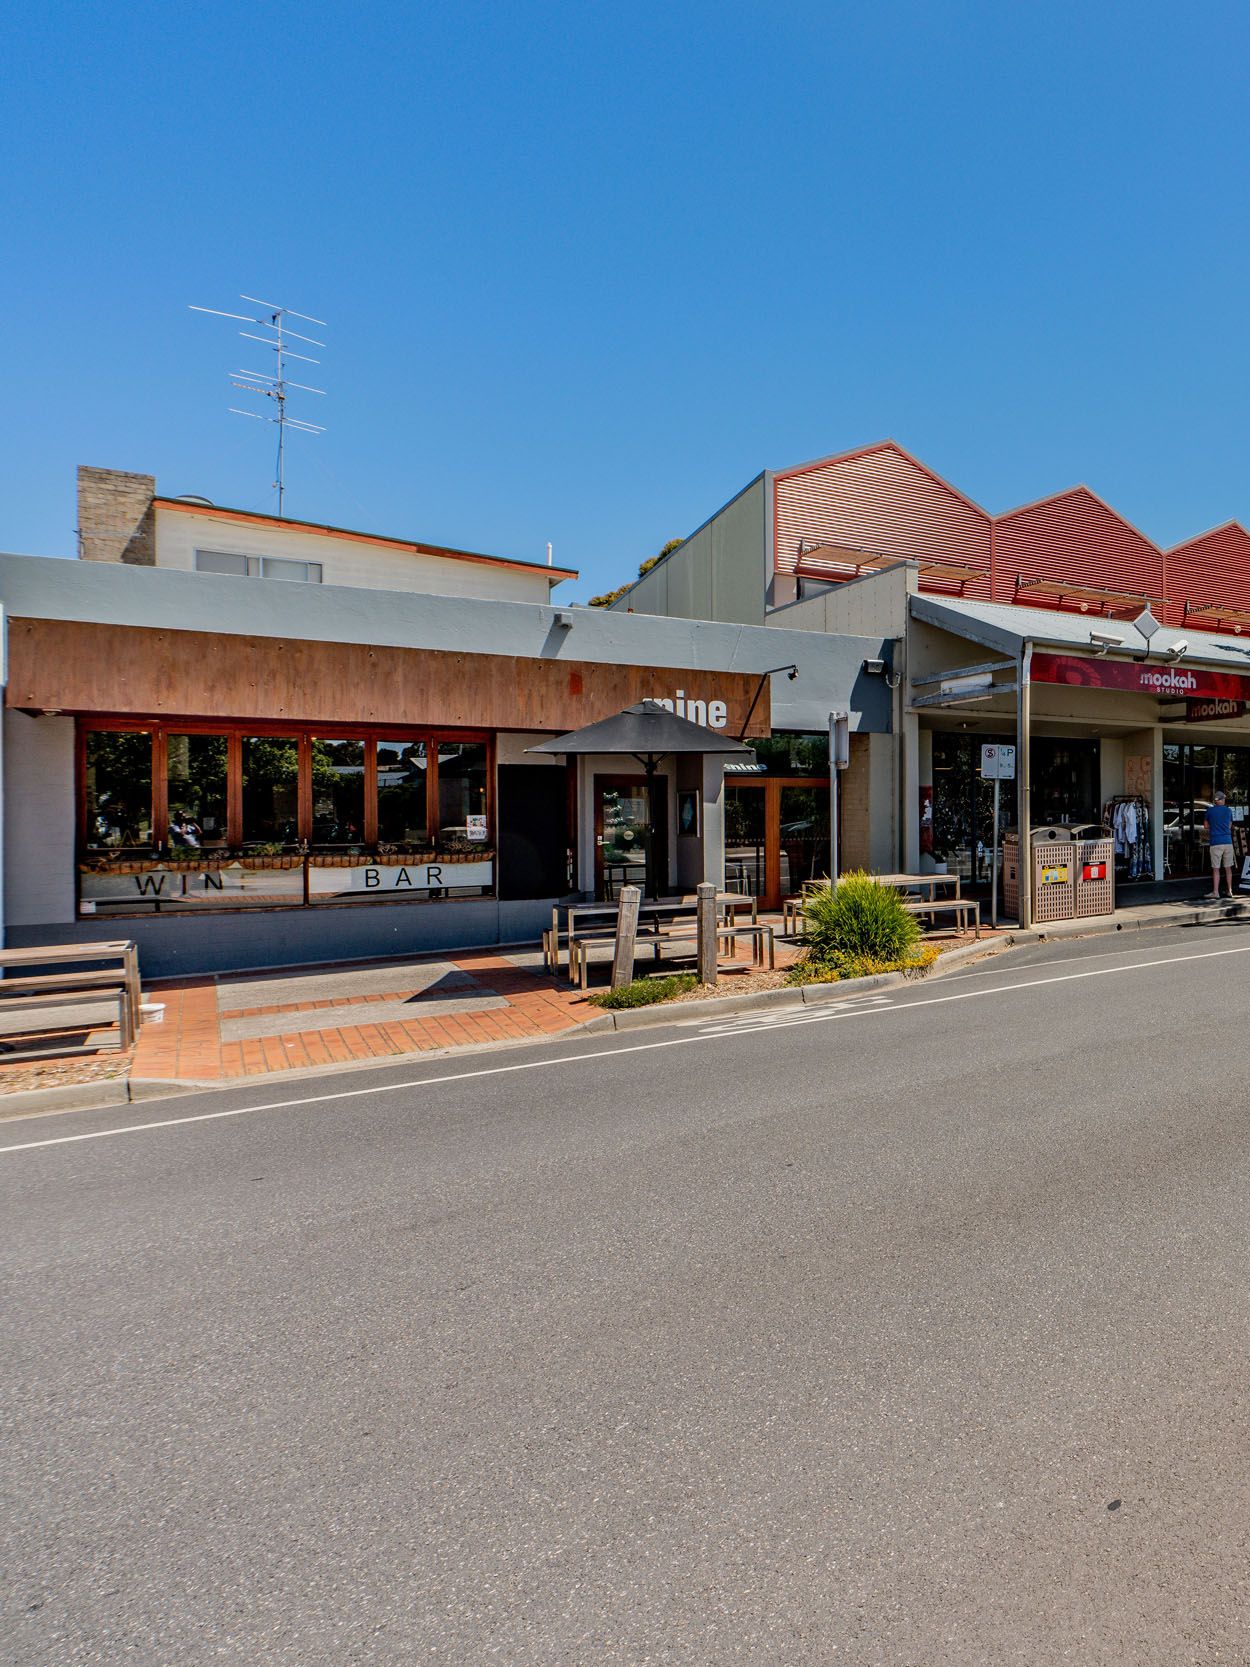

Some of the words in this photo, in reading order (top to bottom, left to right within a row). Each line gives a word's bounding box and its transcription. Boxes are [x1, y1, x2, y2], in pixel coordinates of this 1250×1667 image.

[1140, 668, 1197, 689] mookah
[1156, 686, 1184, 695] STUDIO
[1191, 699, 1238, 718] mookah
[365, 866, 443, 888] BAR
